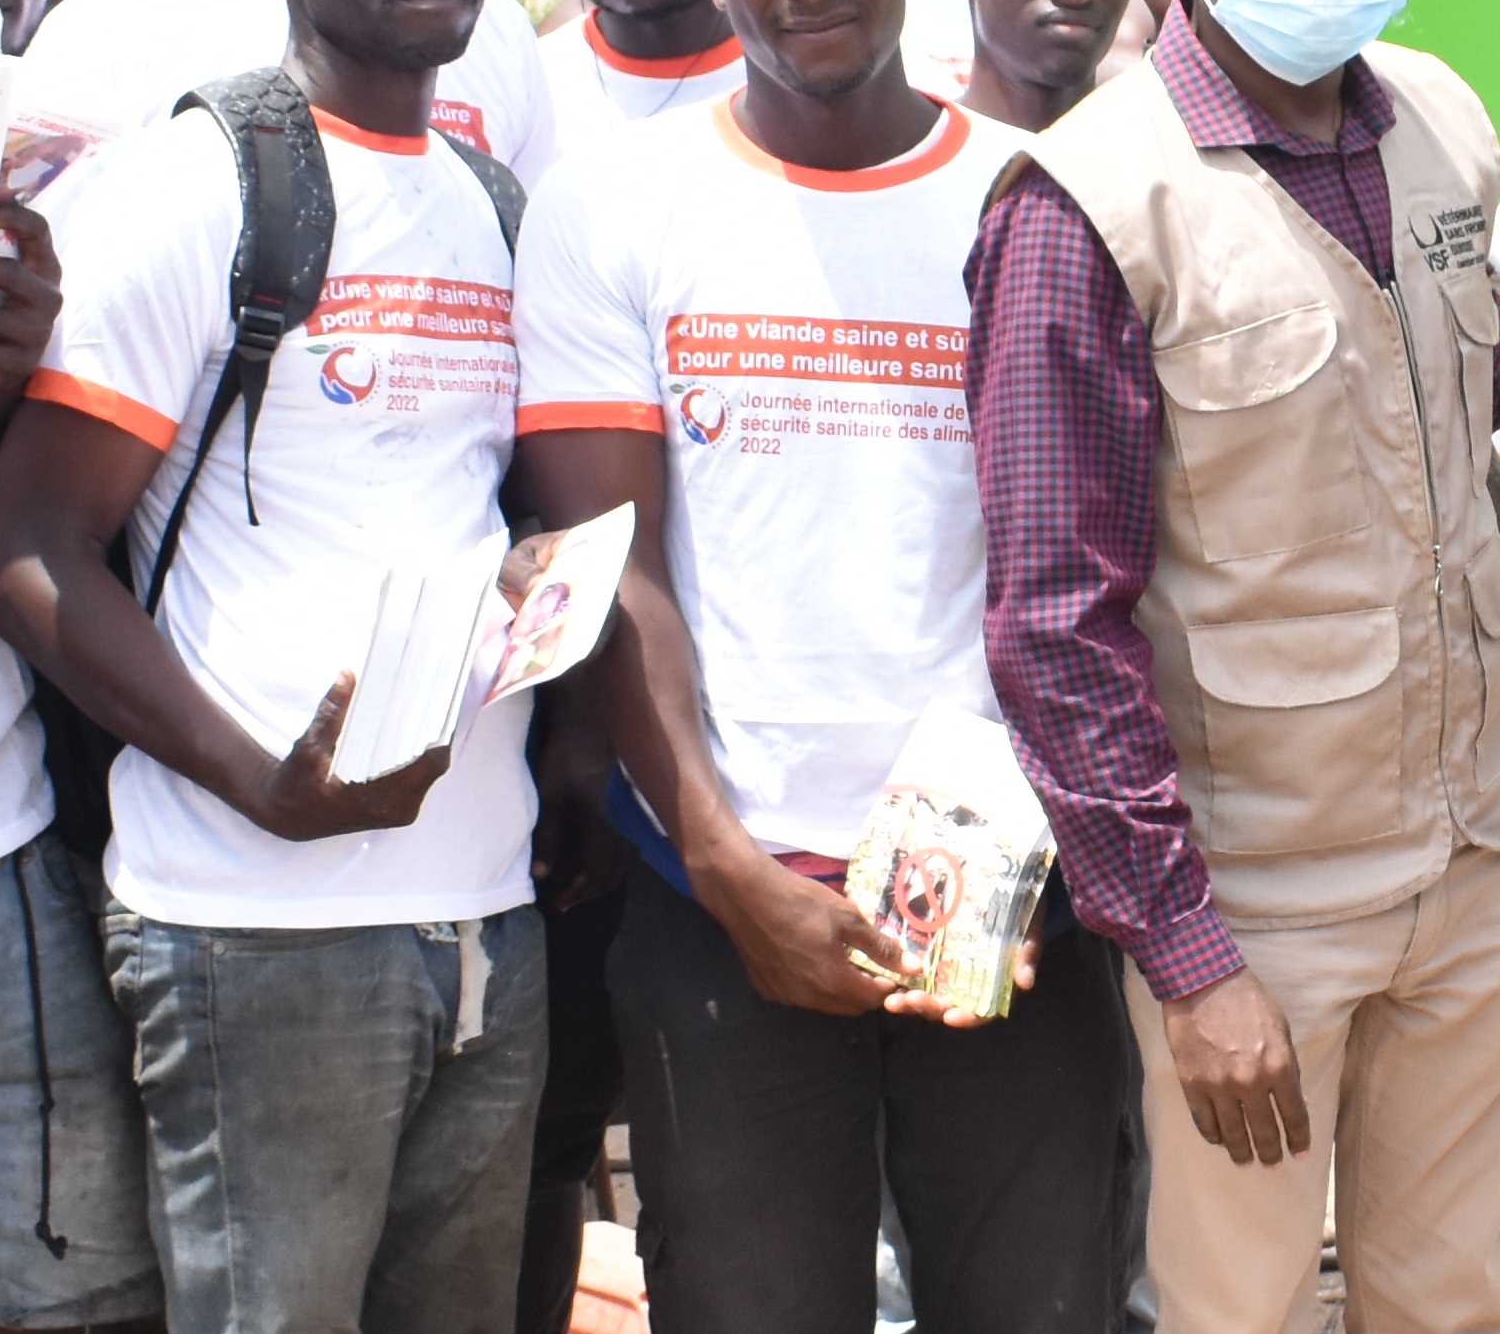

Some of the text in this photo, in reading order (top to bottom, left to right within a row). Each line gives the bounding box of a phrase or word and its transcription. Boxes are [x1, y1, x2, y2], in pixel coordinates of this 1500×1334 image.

[431, 103, 471, 124] sûre
[1424, 249, 1449, 272] VSF
[376, 279, 434, 300] viande
[435, 285, 478, 306] saine
[481, 289, 494, 307] et
[495, 291, 512, 312] sû
[320, 310, 488, 334] pour une meilleure
[677, 317, 969, 353] «Une viande saine et sû
[388, 349, 433, 371] Journée
[677, 351, 964, 381] pour une meilleure sant
[389, 372, 436, 391] sécurité
[439, 377, 492, 395] sanitaire
[386, 395, 420, 412] 2022
[741, 391, 965, 420] Journée internationale de
[740, 414, 975, 443] sécurité sanitaire des alim
[740, 437, 781, 455] 2022
